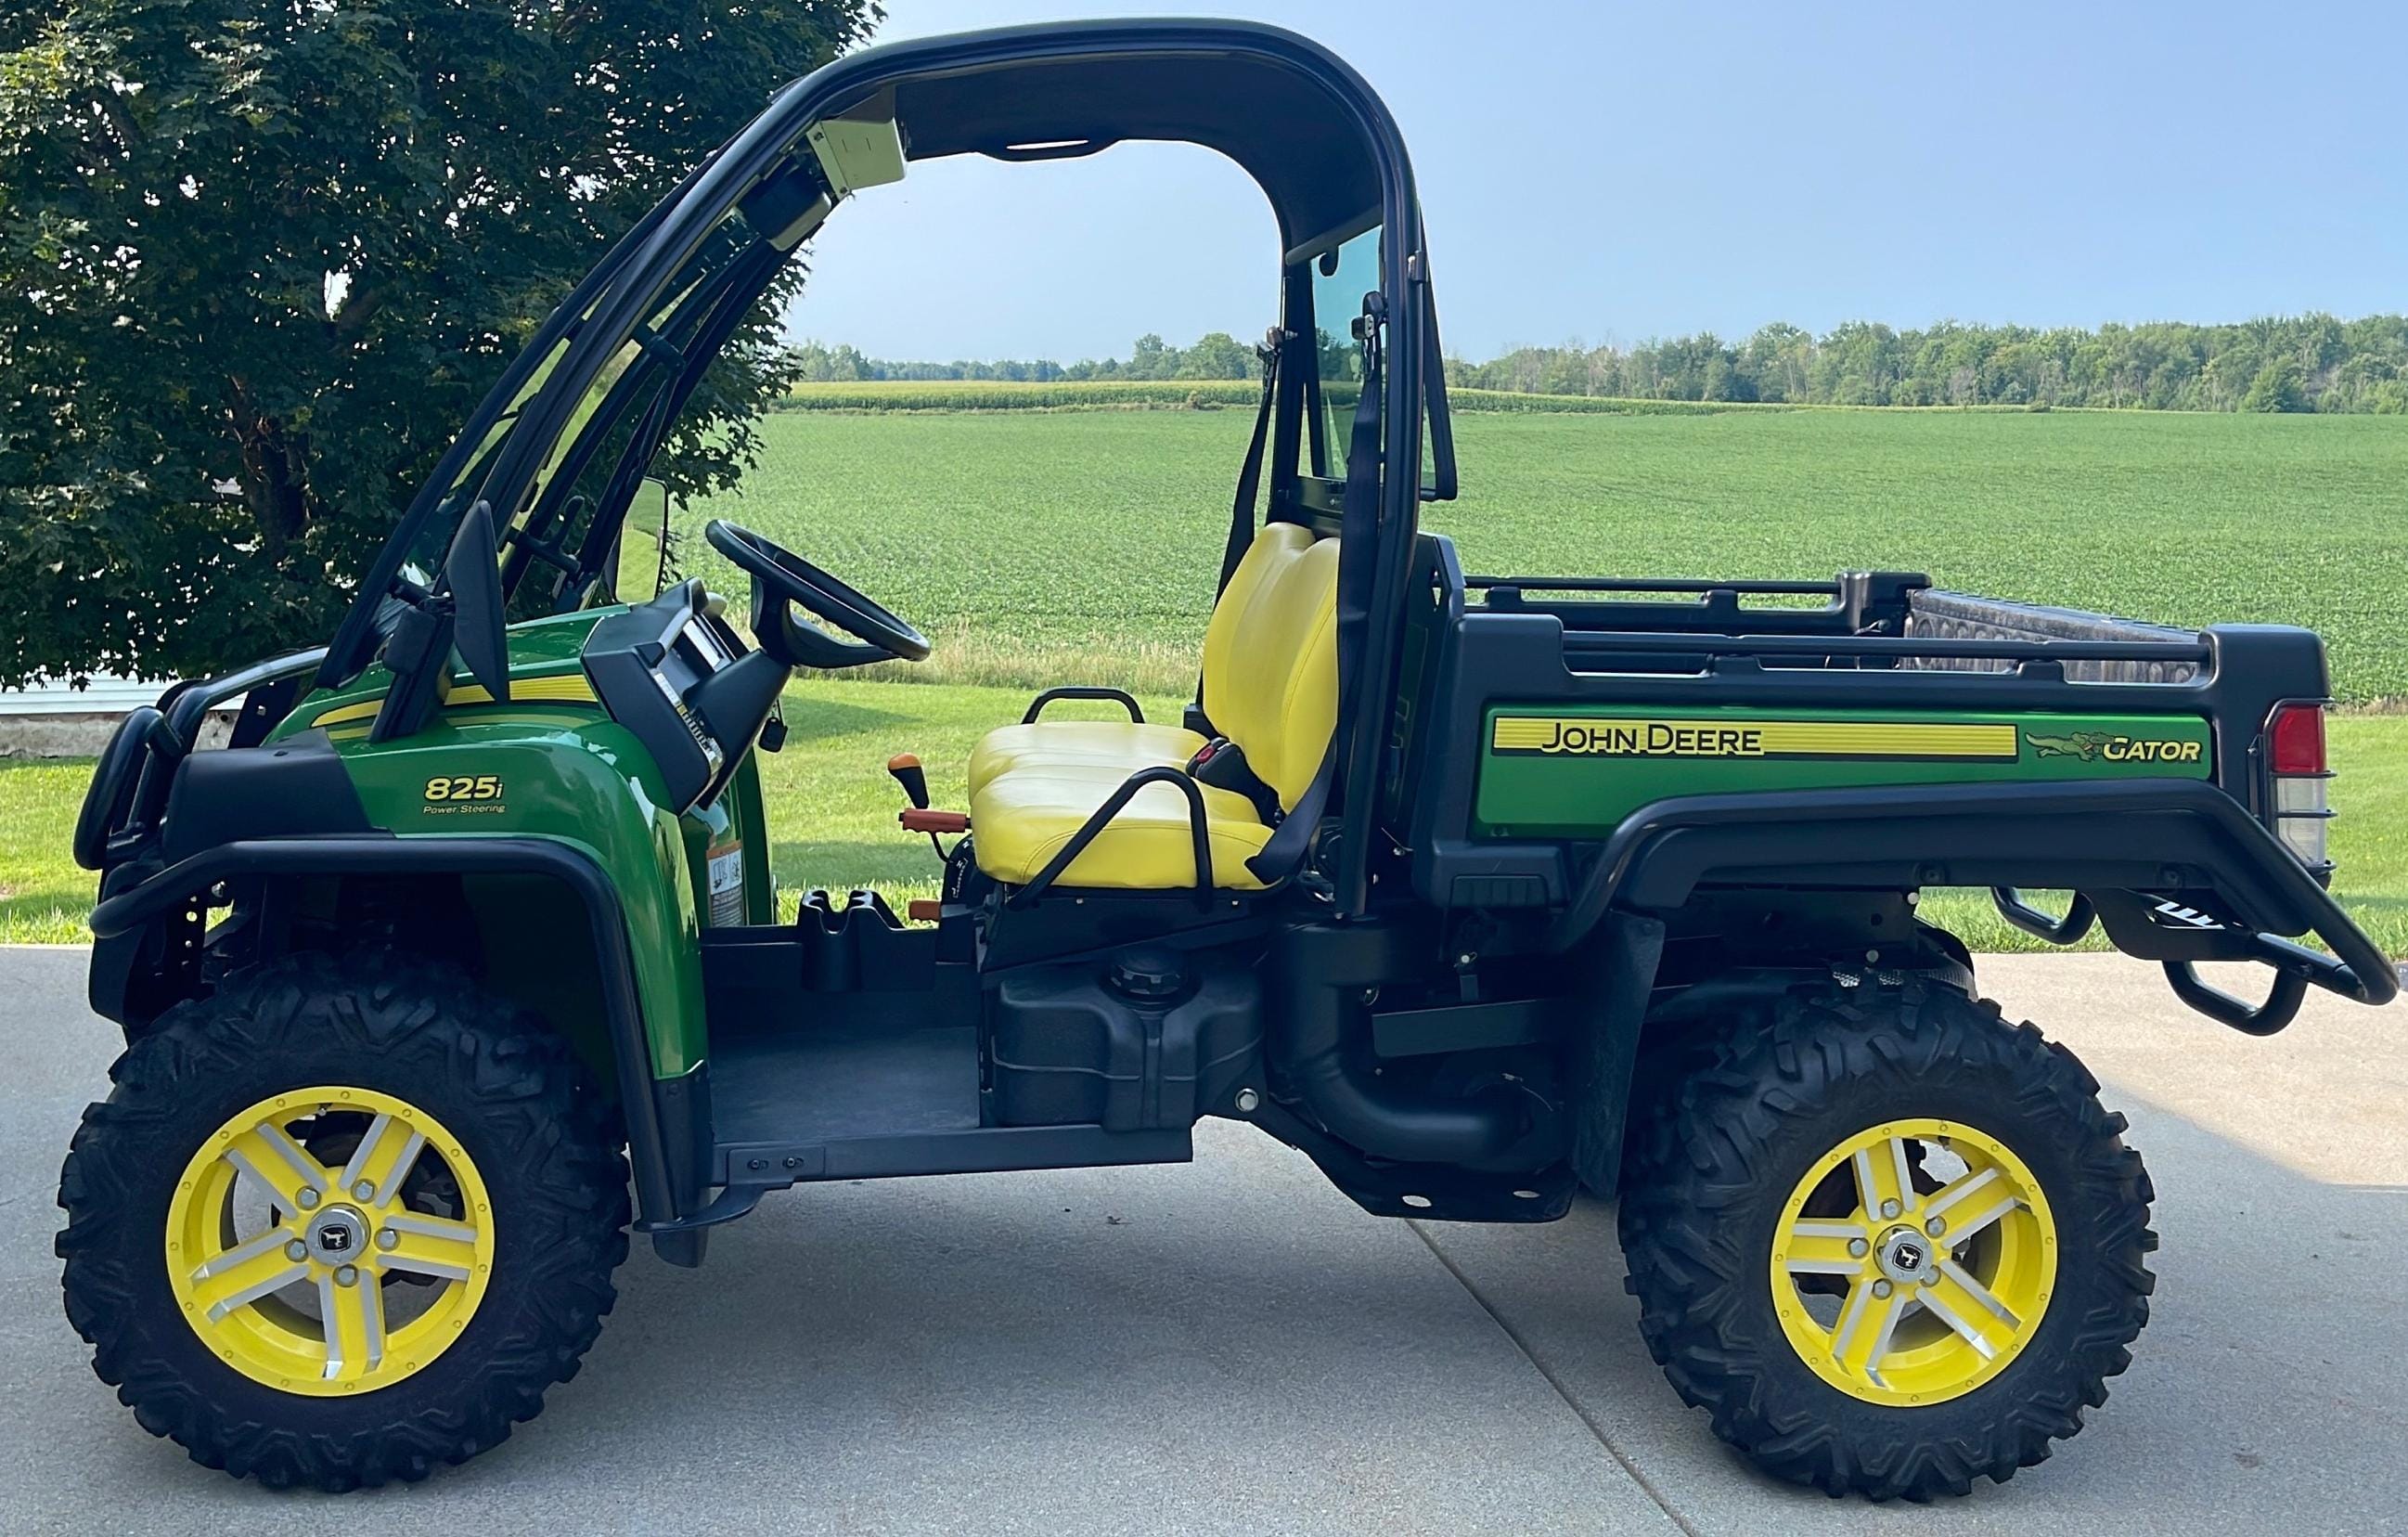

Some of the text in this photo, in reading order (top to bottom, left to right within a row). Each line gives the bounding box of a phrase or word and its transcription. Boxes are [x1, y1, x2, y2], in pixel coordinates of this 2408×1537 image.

[1541, 722, 1762, 753] JOHN DEERE
[2102, 737, 2202, 761] GATOR
[424, 775, 503, 800] 825i
[423, 804, 506, 814] Power Steering
